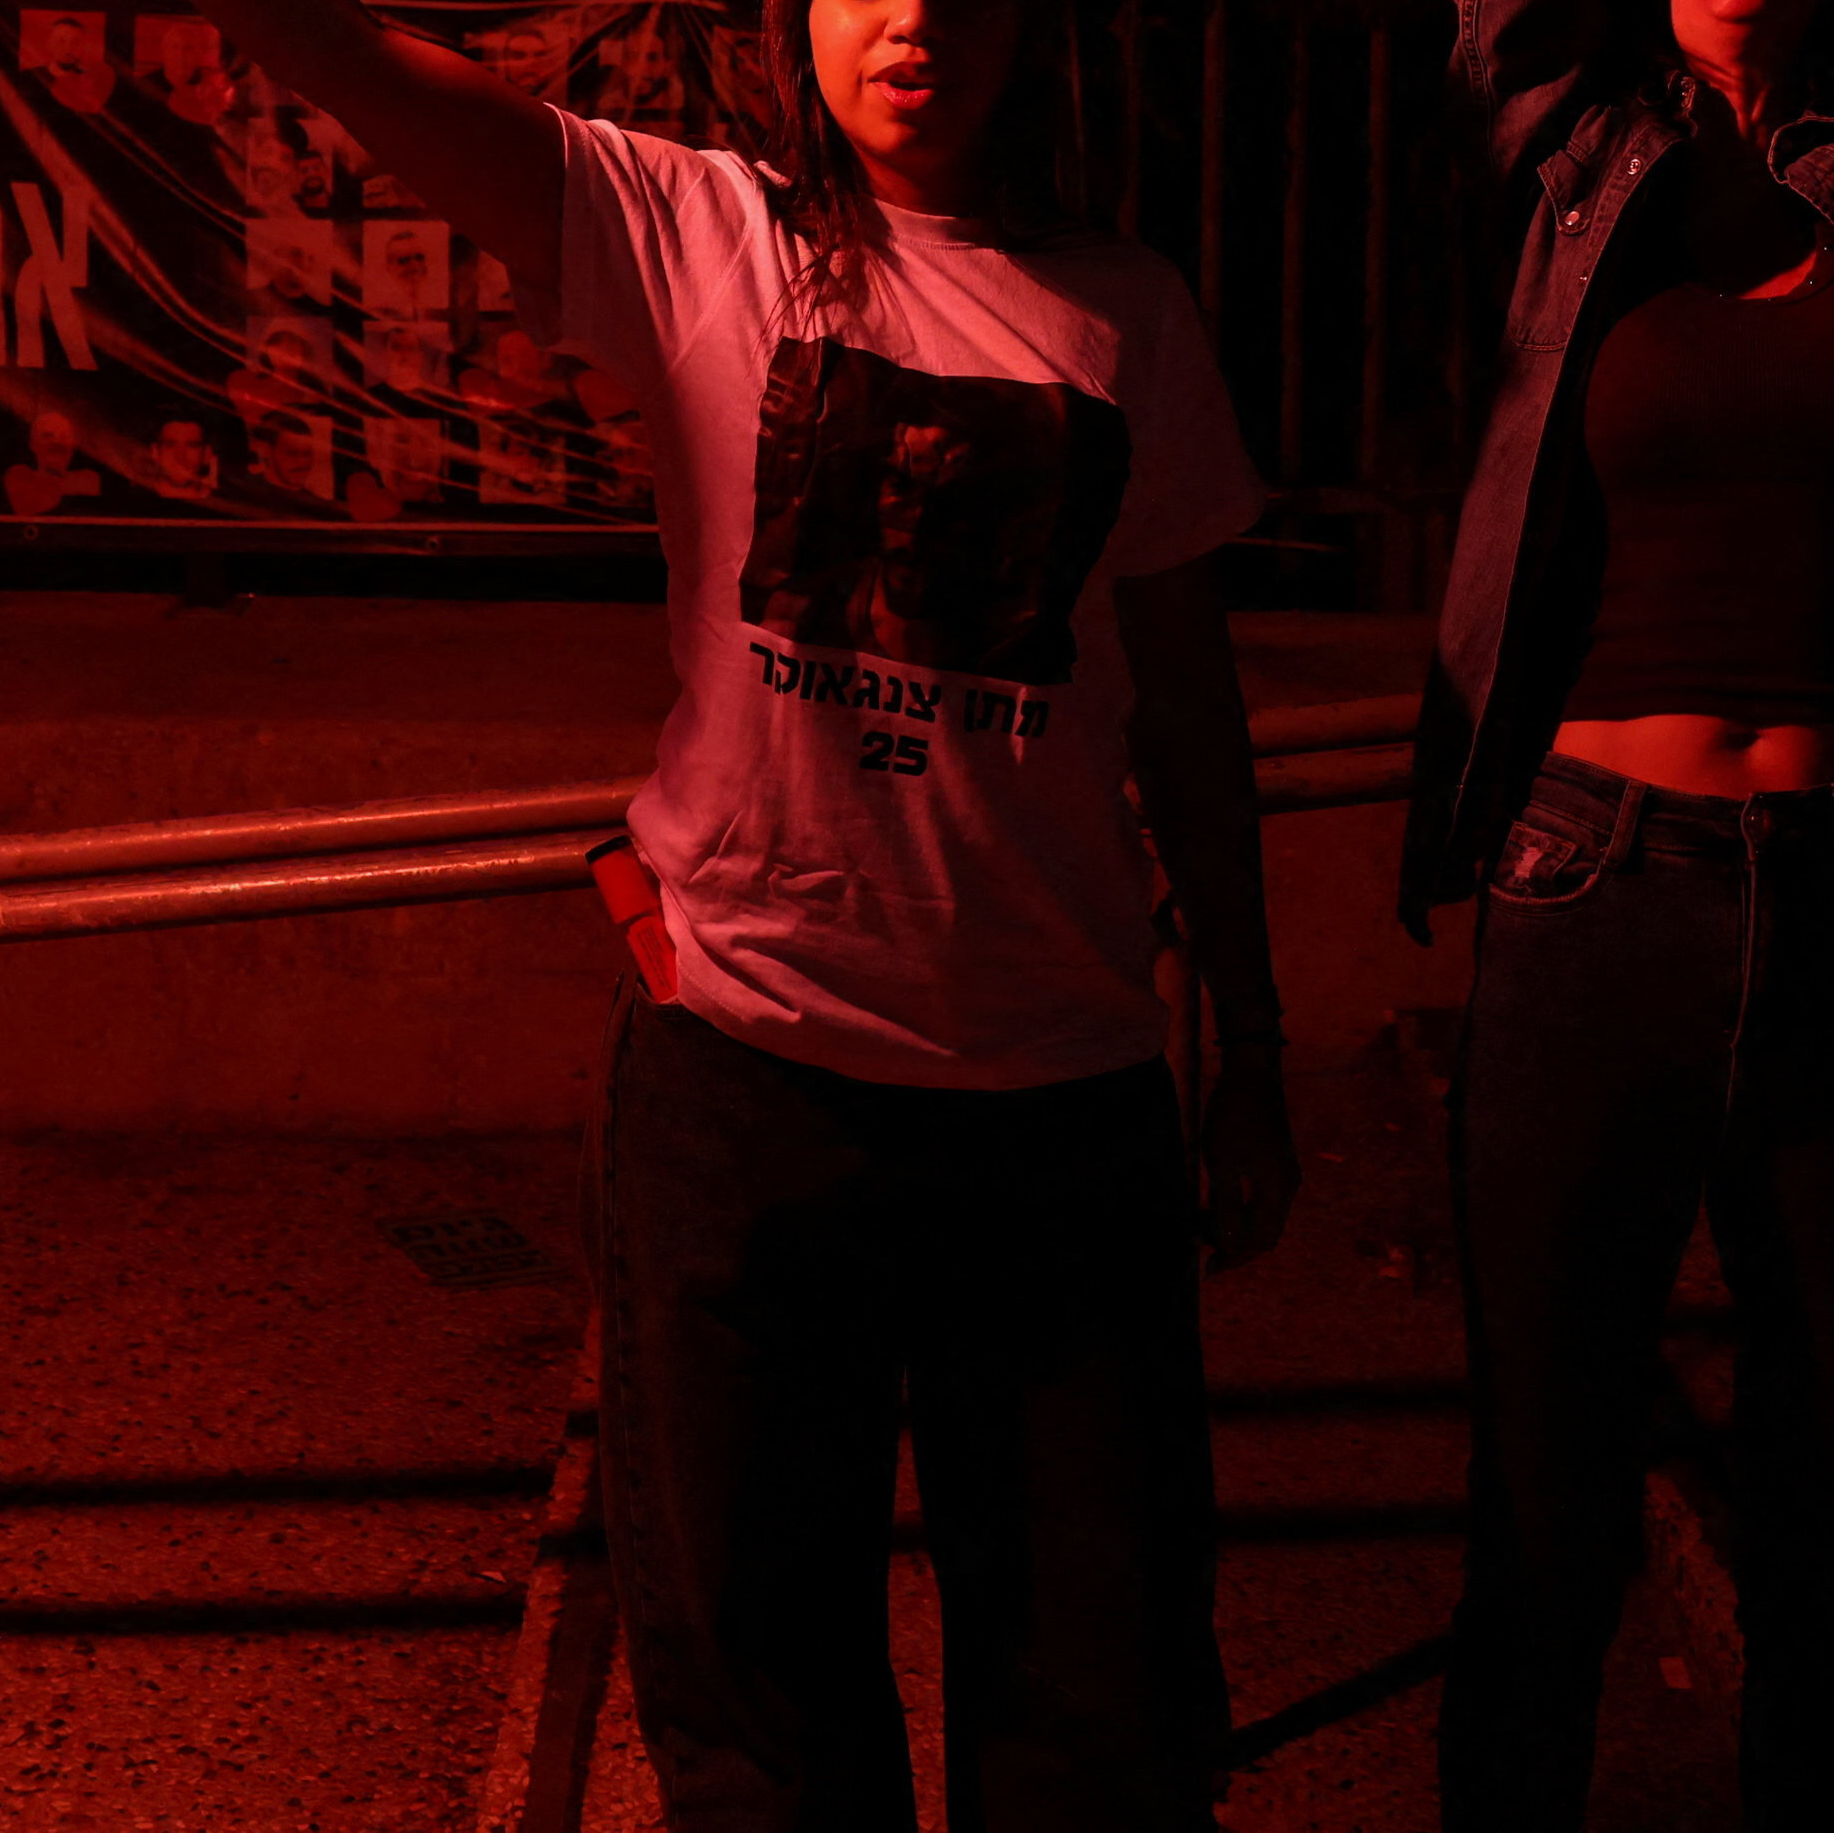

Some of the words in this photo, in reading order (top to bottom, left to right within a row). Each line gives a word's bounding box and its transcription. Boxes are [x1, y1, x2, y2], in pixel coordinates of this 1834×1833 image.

[749, 641, 943, 724] צנגאוקר
[964, 687, 1050, 738] מתן
[859, 730, 930, 777] 25
